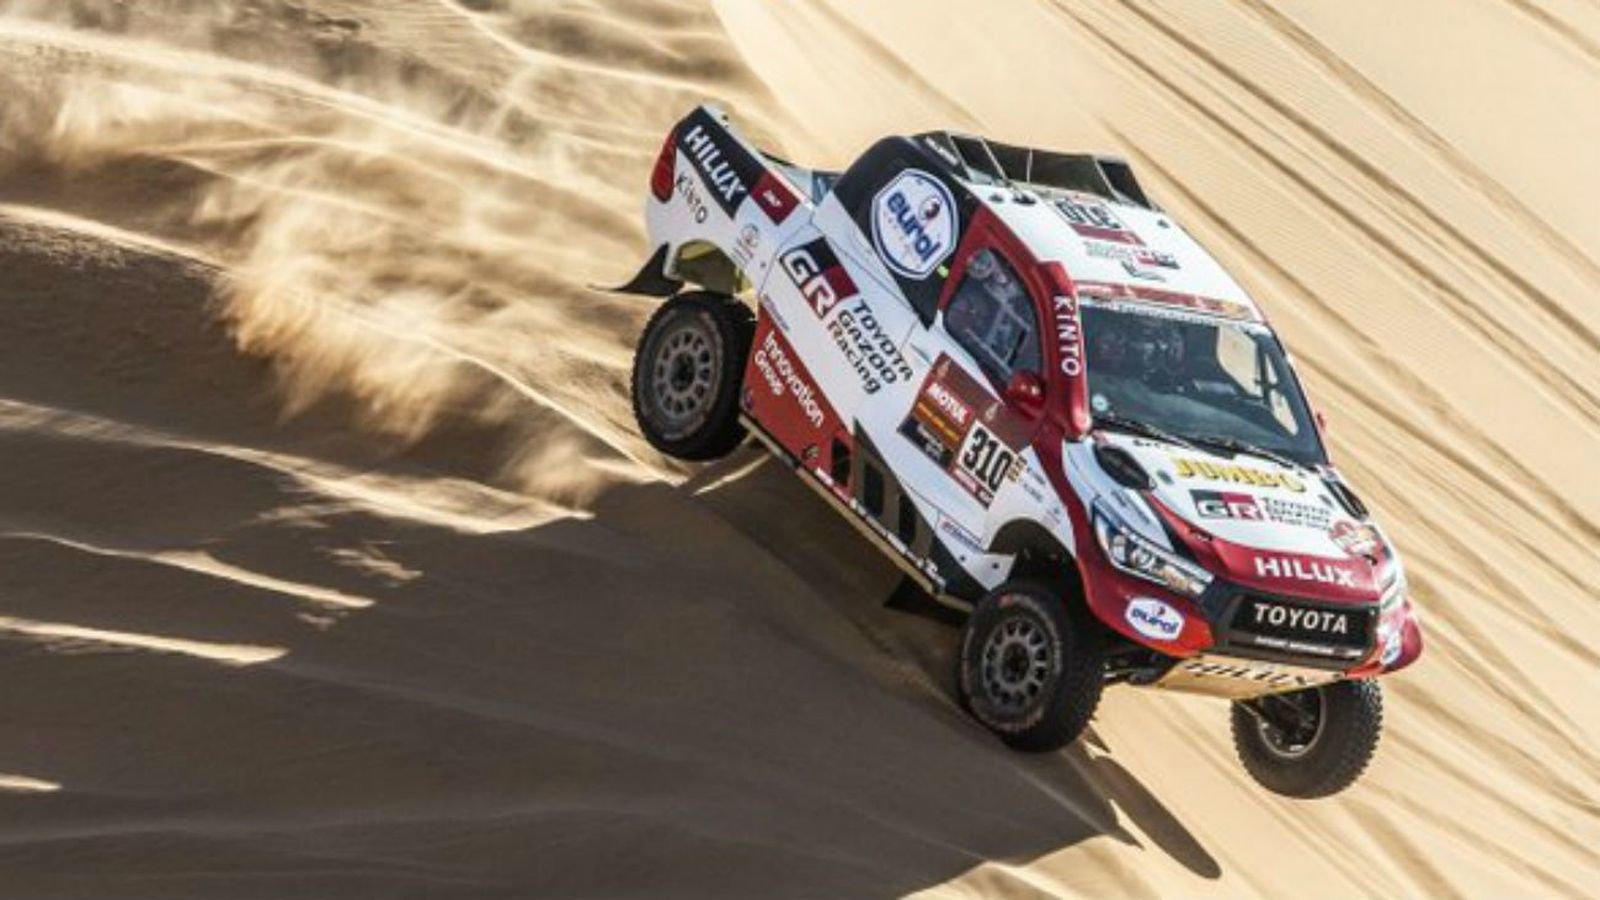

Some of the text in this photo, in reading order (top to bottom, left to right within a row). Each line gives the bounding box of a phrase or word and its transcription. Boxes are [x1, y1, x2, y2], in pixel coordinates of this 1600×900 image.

[684, 124, 748, 202] HILUX
[886, 191, 943, 264] eurol
[783, 250, 838, 320] GR
[826, 319, 881, 395] Racing
[838, 308, 898, 384] GAZOO
[852, 298, 914, 382] TOYOTA
[1054, 295, 1082, 376] KINTO
[754, 350, 785, 397] Group
[763, 330, 825, 428] Innovation
[963, 427, 1014, 493] 310
[1197, 500, 1264, 521] GR
[1254, 556, 1354, 588] HILUX
[1131, 605, 1179, 635] eurol
[1253, 603, 1348, 635] TOYOTA
